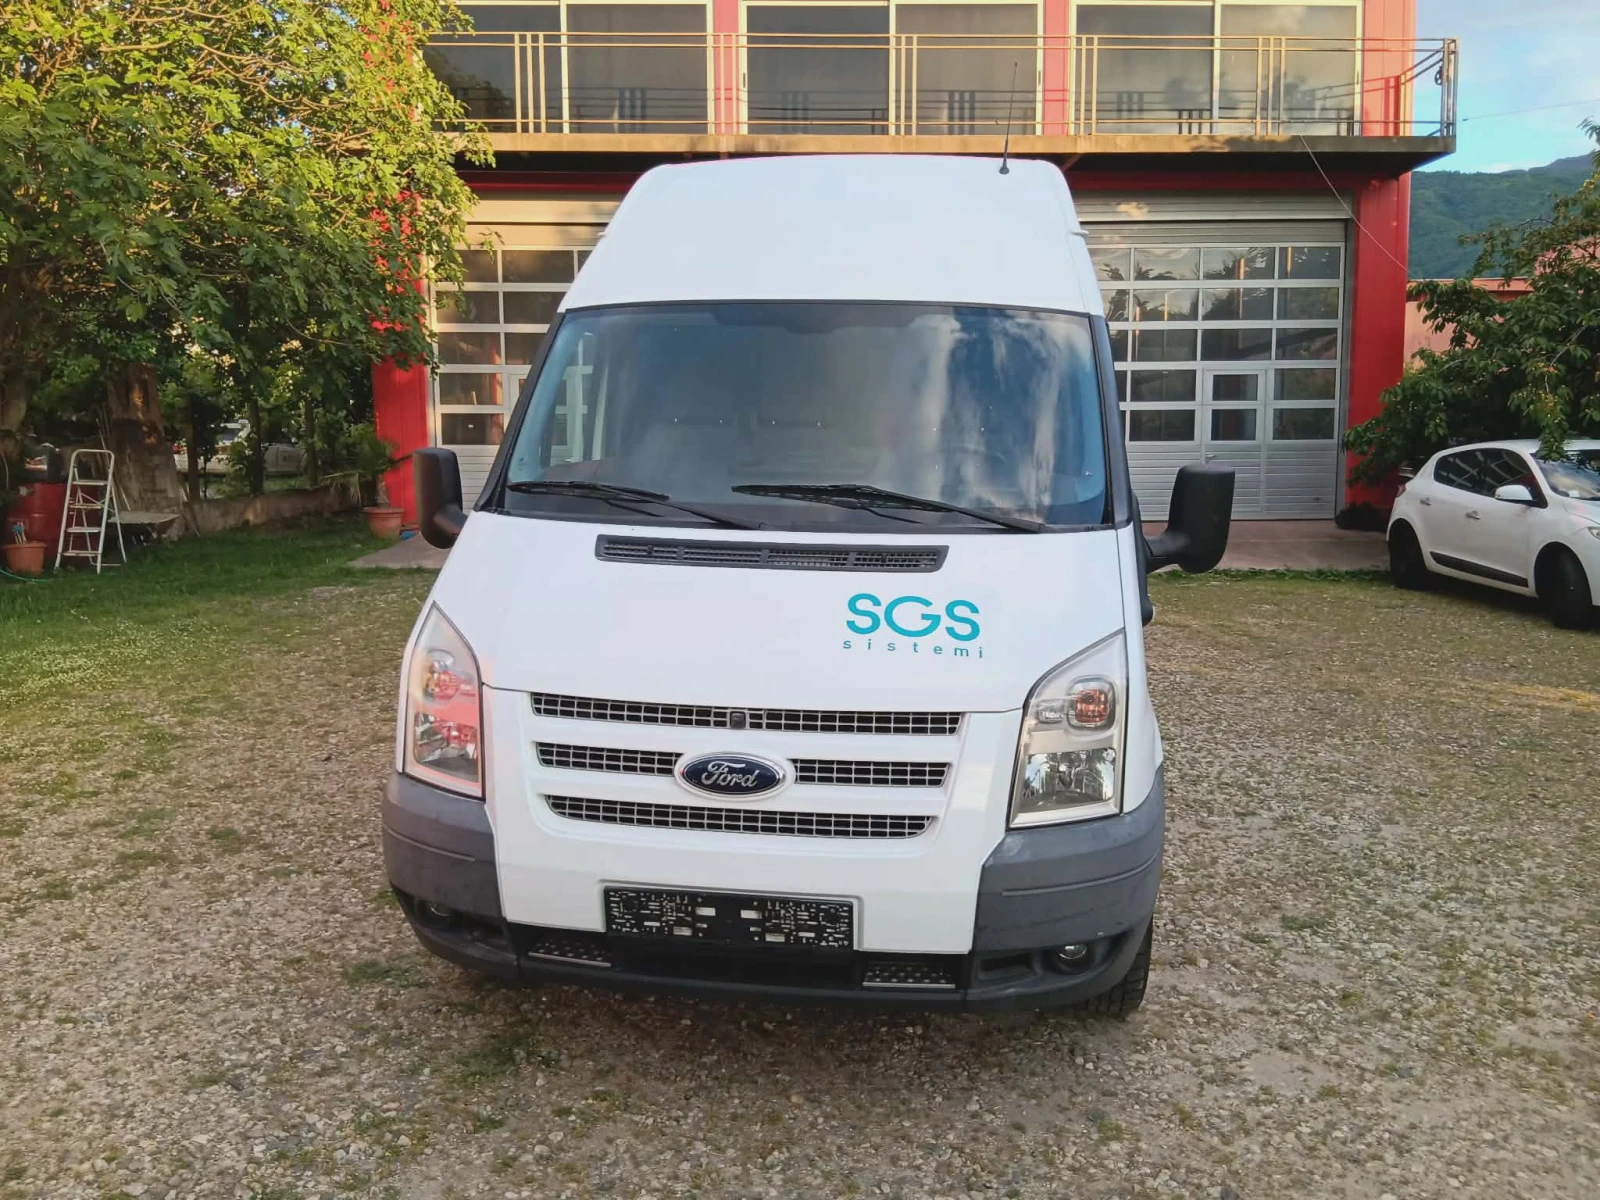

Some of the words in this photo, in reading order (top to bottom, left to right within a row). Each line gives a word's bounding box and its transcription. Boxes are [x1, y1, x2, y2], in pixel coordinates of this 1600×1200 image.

[846, 593, 981, 642] SGS
[843, 639, 984, 659] sistemi
[701, 760, 760, 787] Ford
